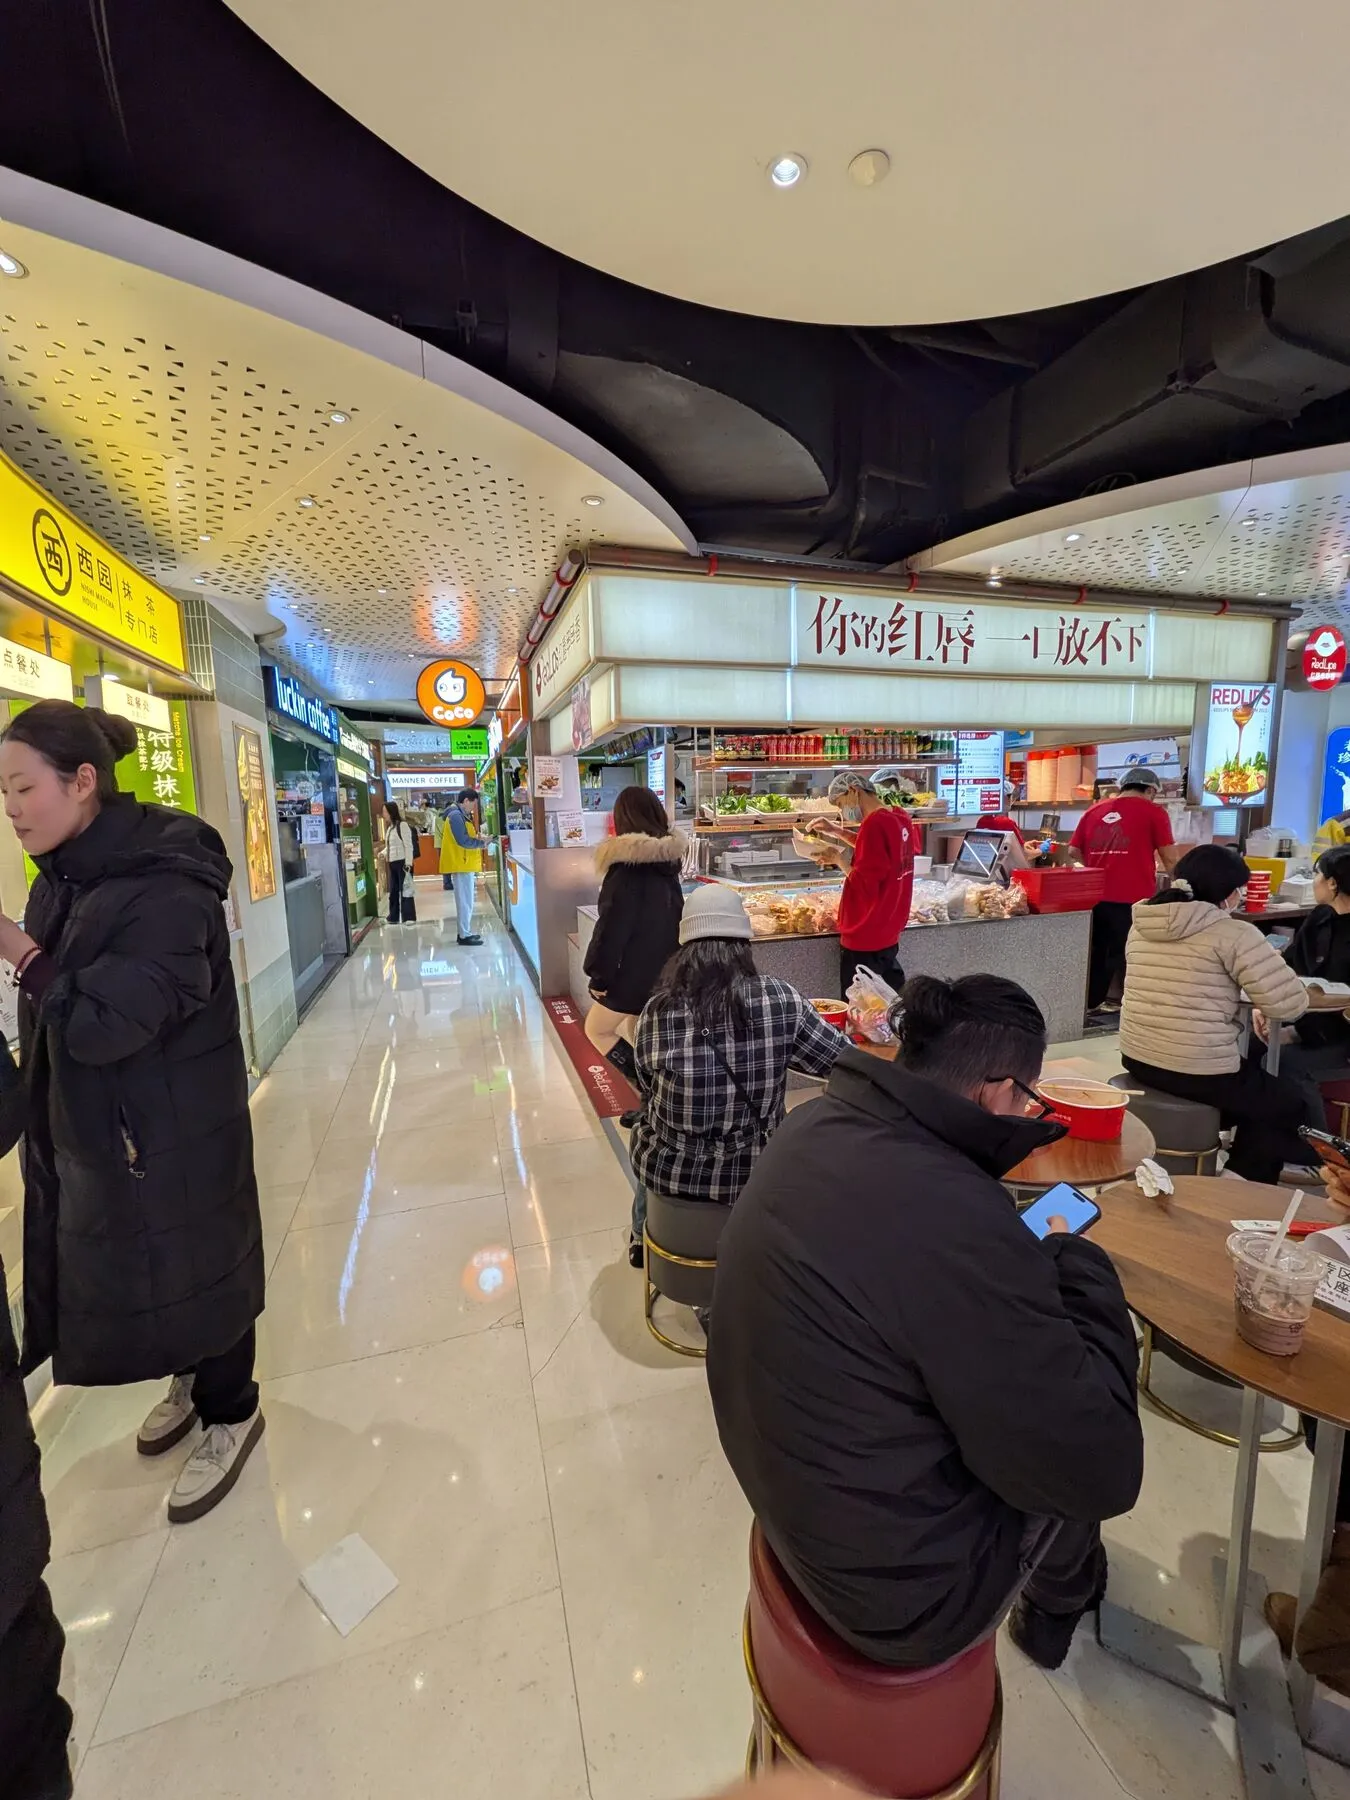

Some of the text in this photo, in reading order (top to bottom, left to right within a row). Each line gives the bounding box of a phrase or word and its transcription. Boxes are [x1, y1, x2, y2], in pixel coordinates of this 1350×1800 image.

[76, 543, 113, 594] 西园
[121, 578, 156, 617] 抹茶
[125, 610, 158, 644] 专门店
[806, 595, 1147, 667] 你的红唇 一口放不下
[3, 648, 40, 678] 点餐处
[275, 666, 331, 739] luckin coffee
[432, 706, 474, 721] CoCo
[1212, 688, 1271, 705] REDLIPS
[429, 776, 457, 784] COFFEE
